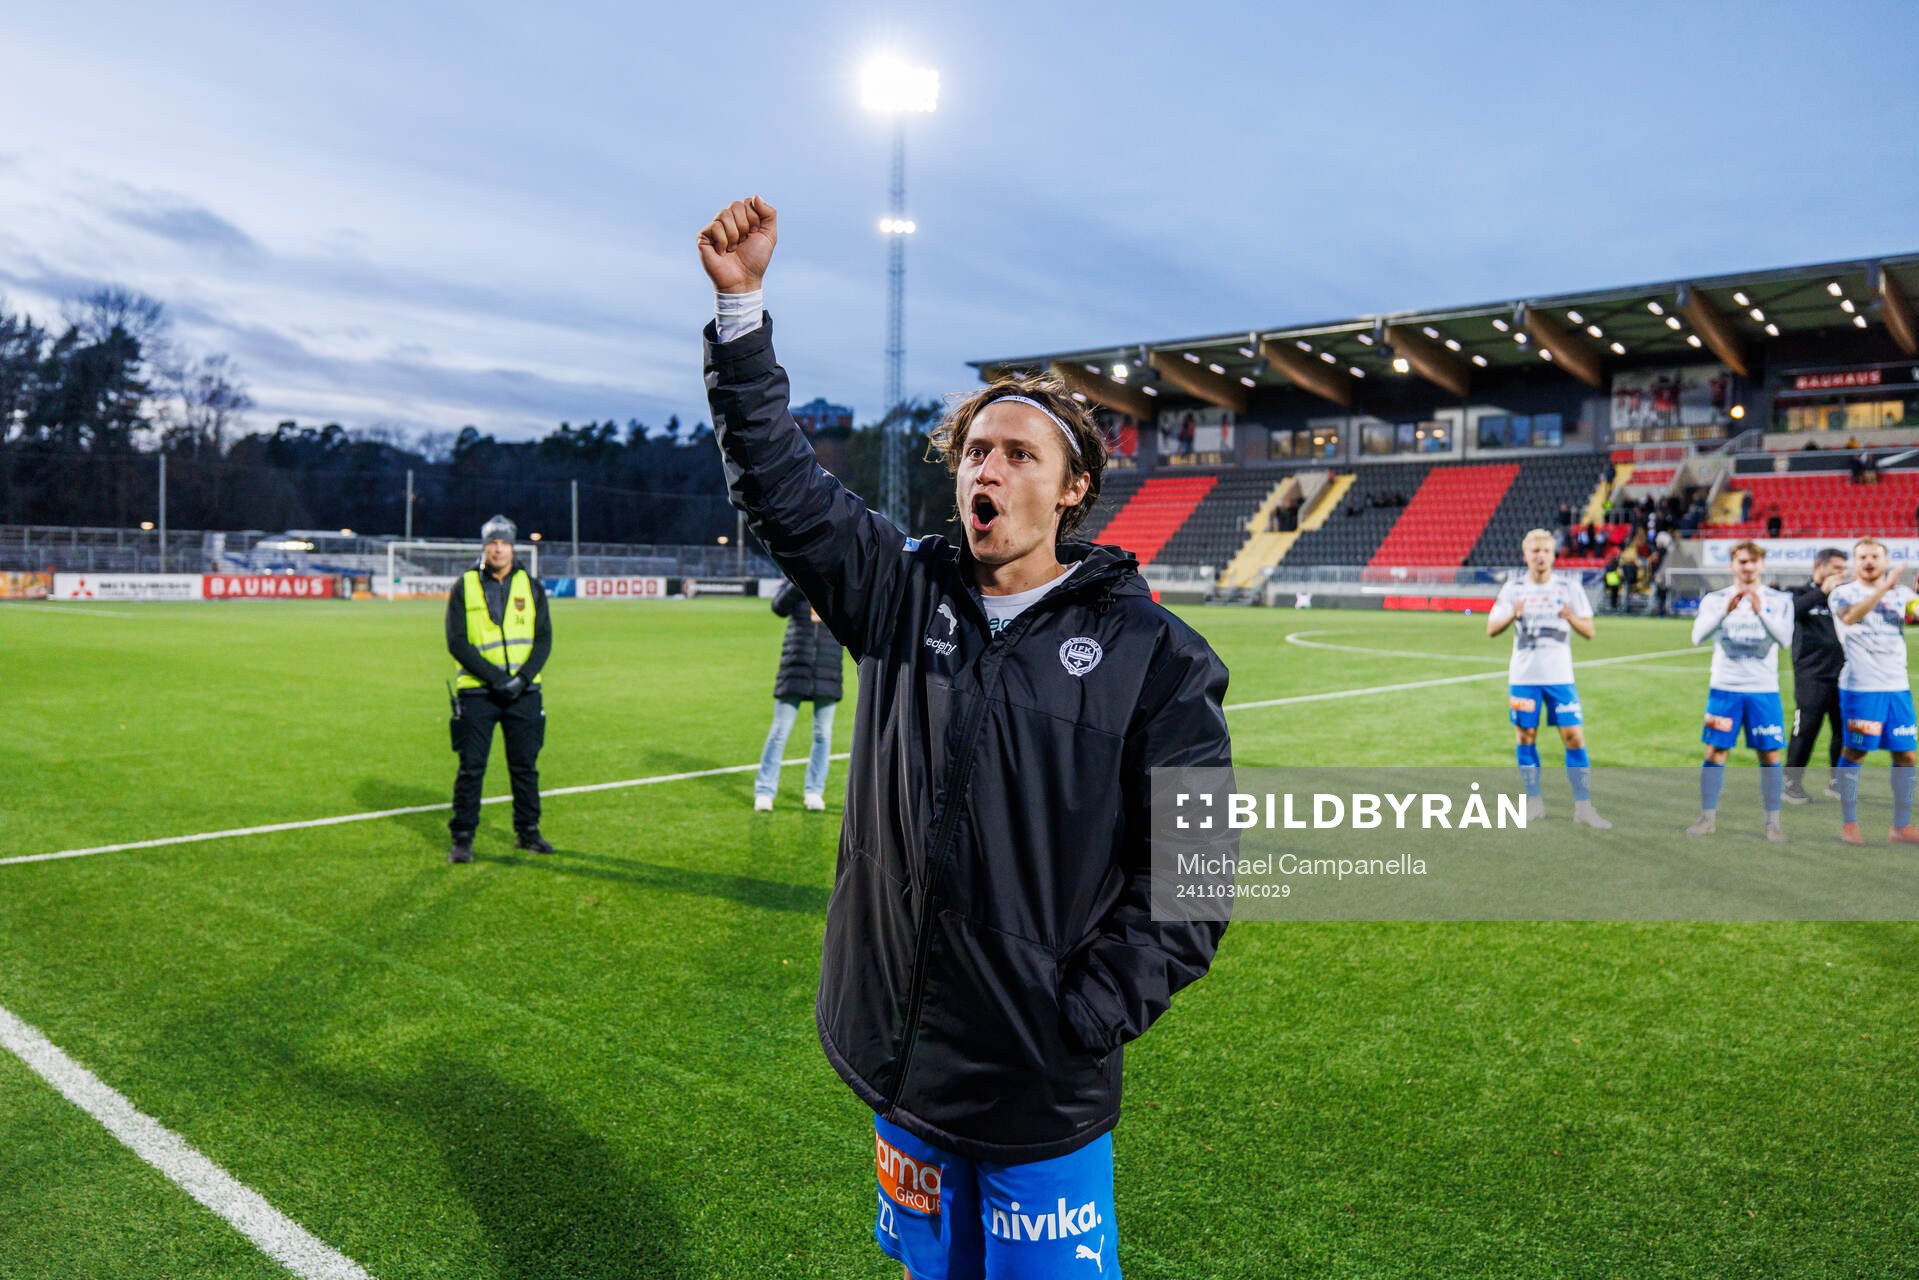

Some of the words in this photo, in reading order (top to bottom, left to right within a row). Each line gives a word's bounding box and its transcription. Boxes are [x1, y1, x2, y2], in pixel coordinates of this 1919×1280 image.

[210, 578, 325, 596] BAUHAUS
[1074, 644, 1092, 654] IFK
[991, 1198, 1102, 1241] nivika.
